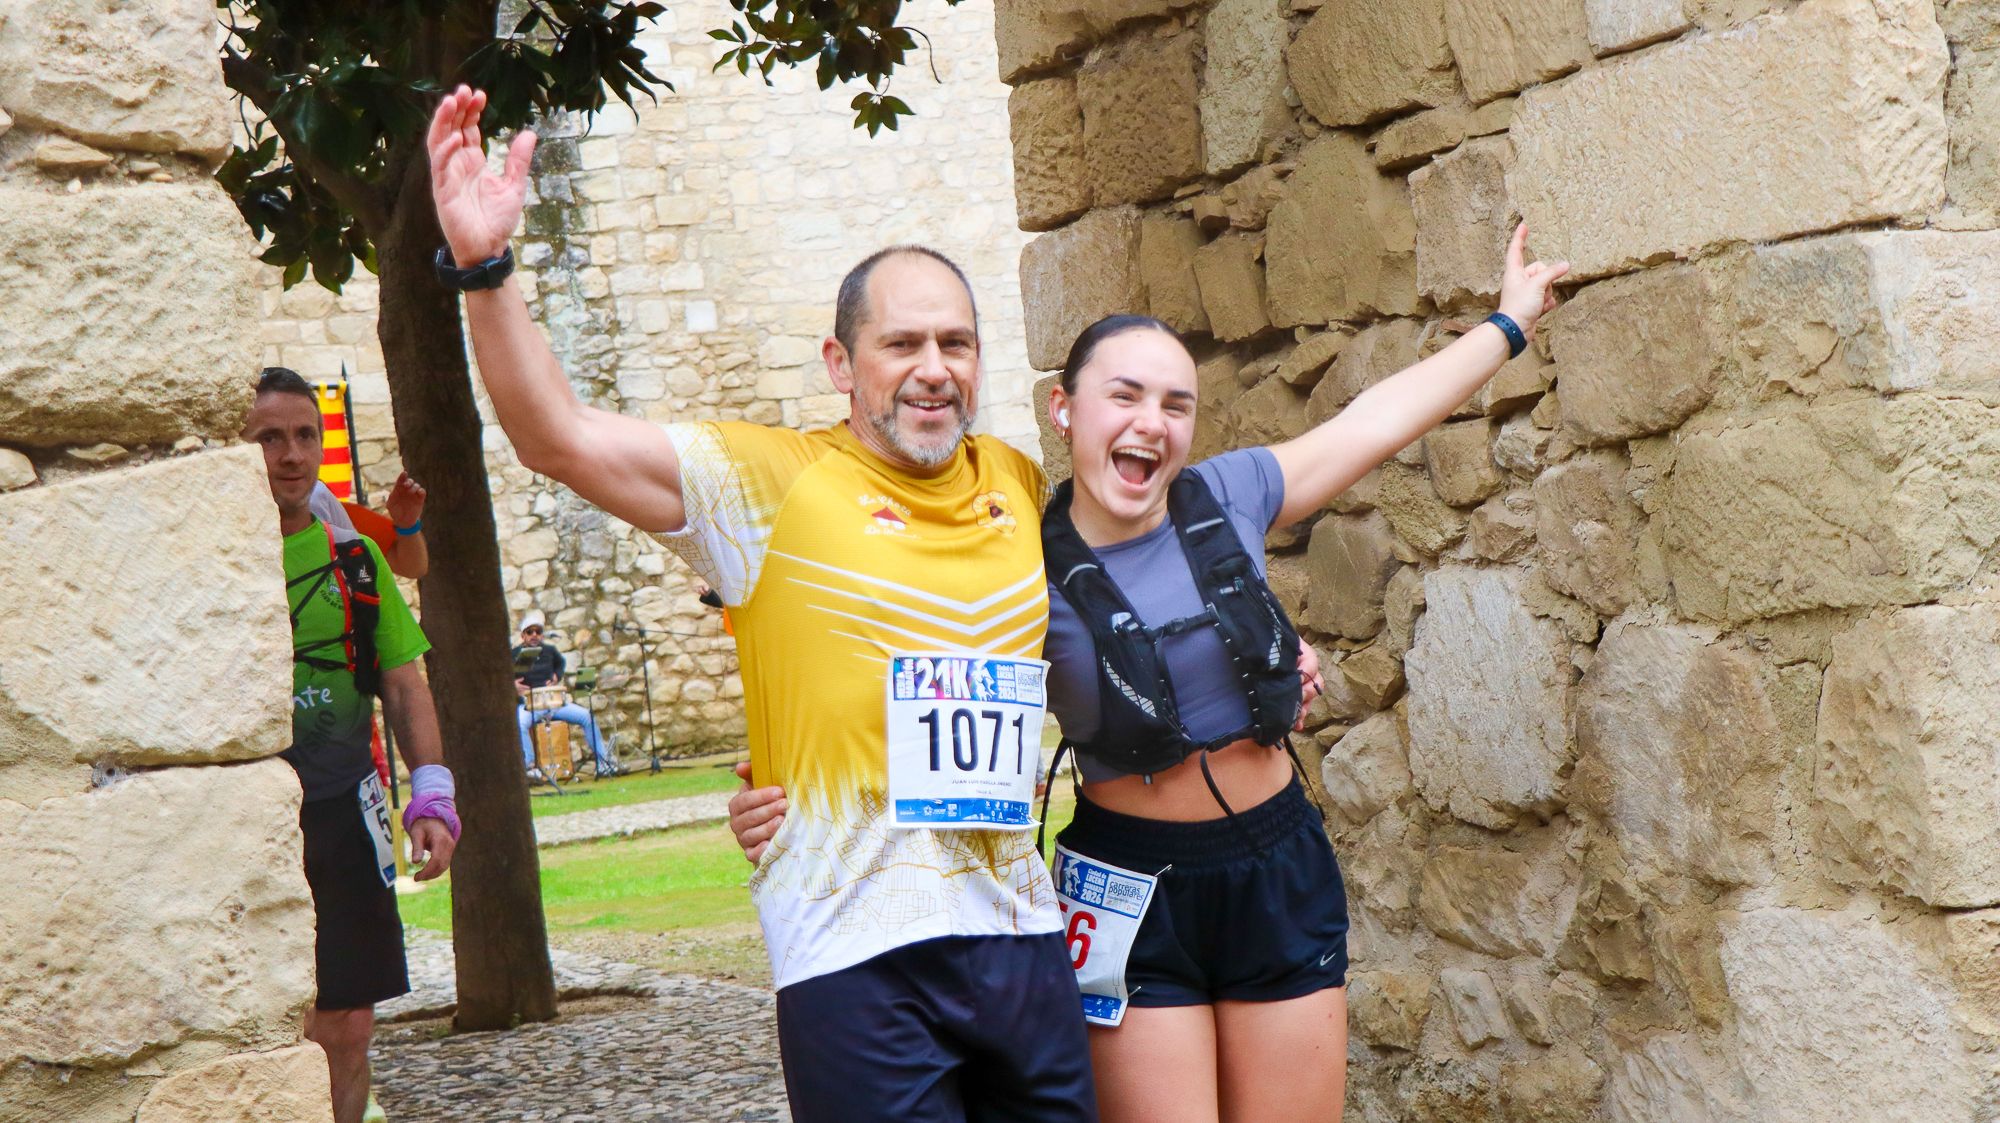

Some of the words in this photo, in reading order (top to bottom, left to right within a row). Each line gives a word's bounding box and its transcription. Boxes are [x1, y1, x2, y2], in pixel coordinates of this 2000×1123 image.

[916, 658, 972, 699] 21K
[998, 687, 1016, 700] 2026
[918, 707, 1024, 775] 1071
[1108, 886, 1144, 901] populares
[1109, 881, 1141, 893] carreras
[1080, 888, 1102, 905] 2026
